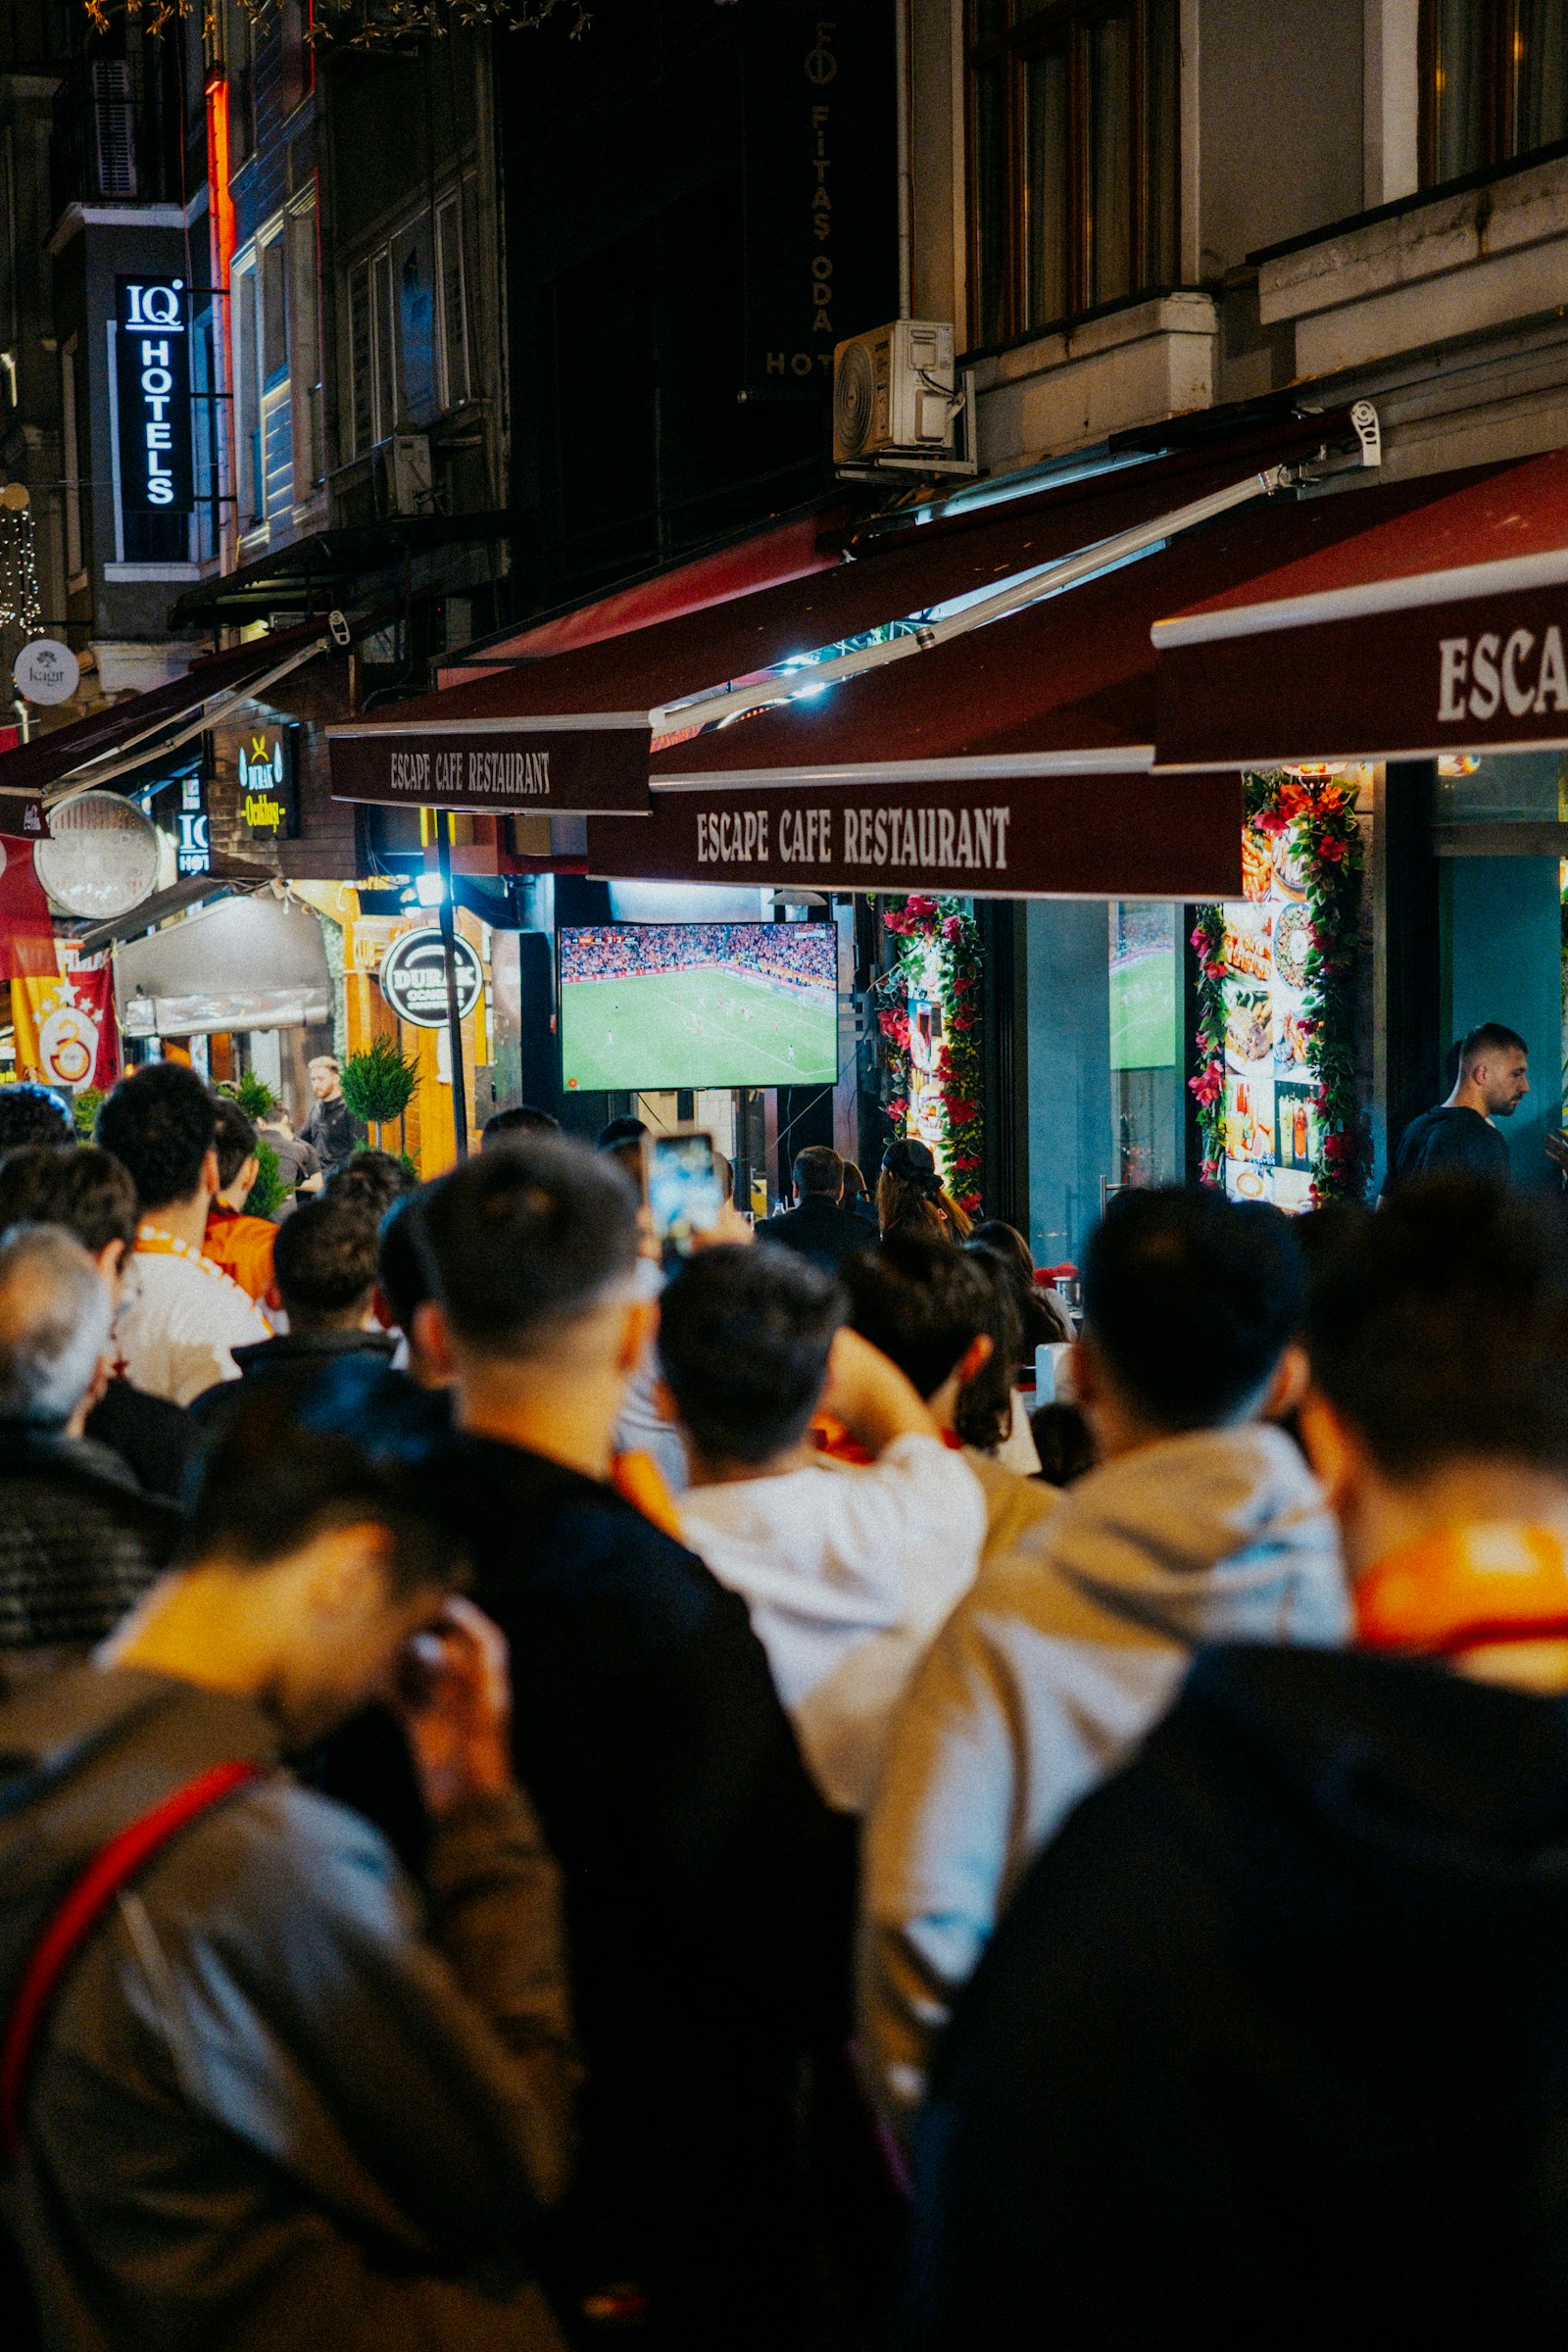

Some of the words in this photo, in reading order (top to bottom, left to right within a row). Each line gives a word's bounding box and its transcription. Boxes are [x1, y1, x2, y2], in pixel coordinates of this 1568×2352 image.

[126, 284, 182, 326] IQ
[811, 255, 834, 333] ODA
[141, 339, 174, 505] HOTELS
[1437, 625, 1568, 722] ESCA
[391, 752, 430, 791] ESCAPE
[435, 752, 463, 791] CAFE
[468, 751, 551, 795] RESTAURANT
[697, 810, 769, 862] ESCAPE
[779, 808, 832, 863] CAFE
[844, 807, 1010, 870] RESTAURANT
